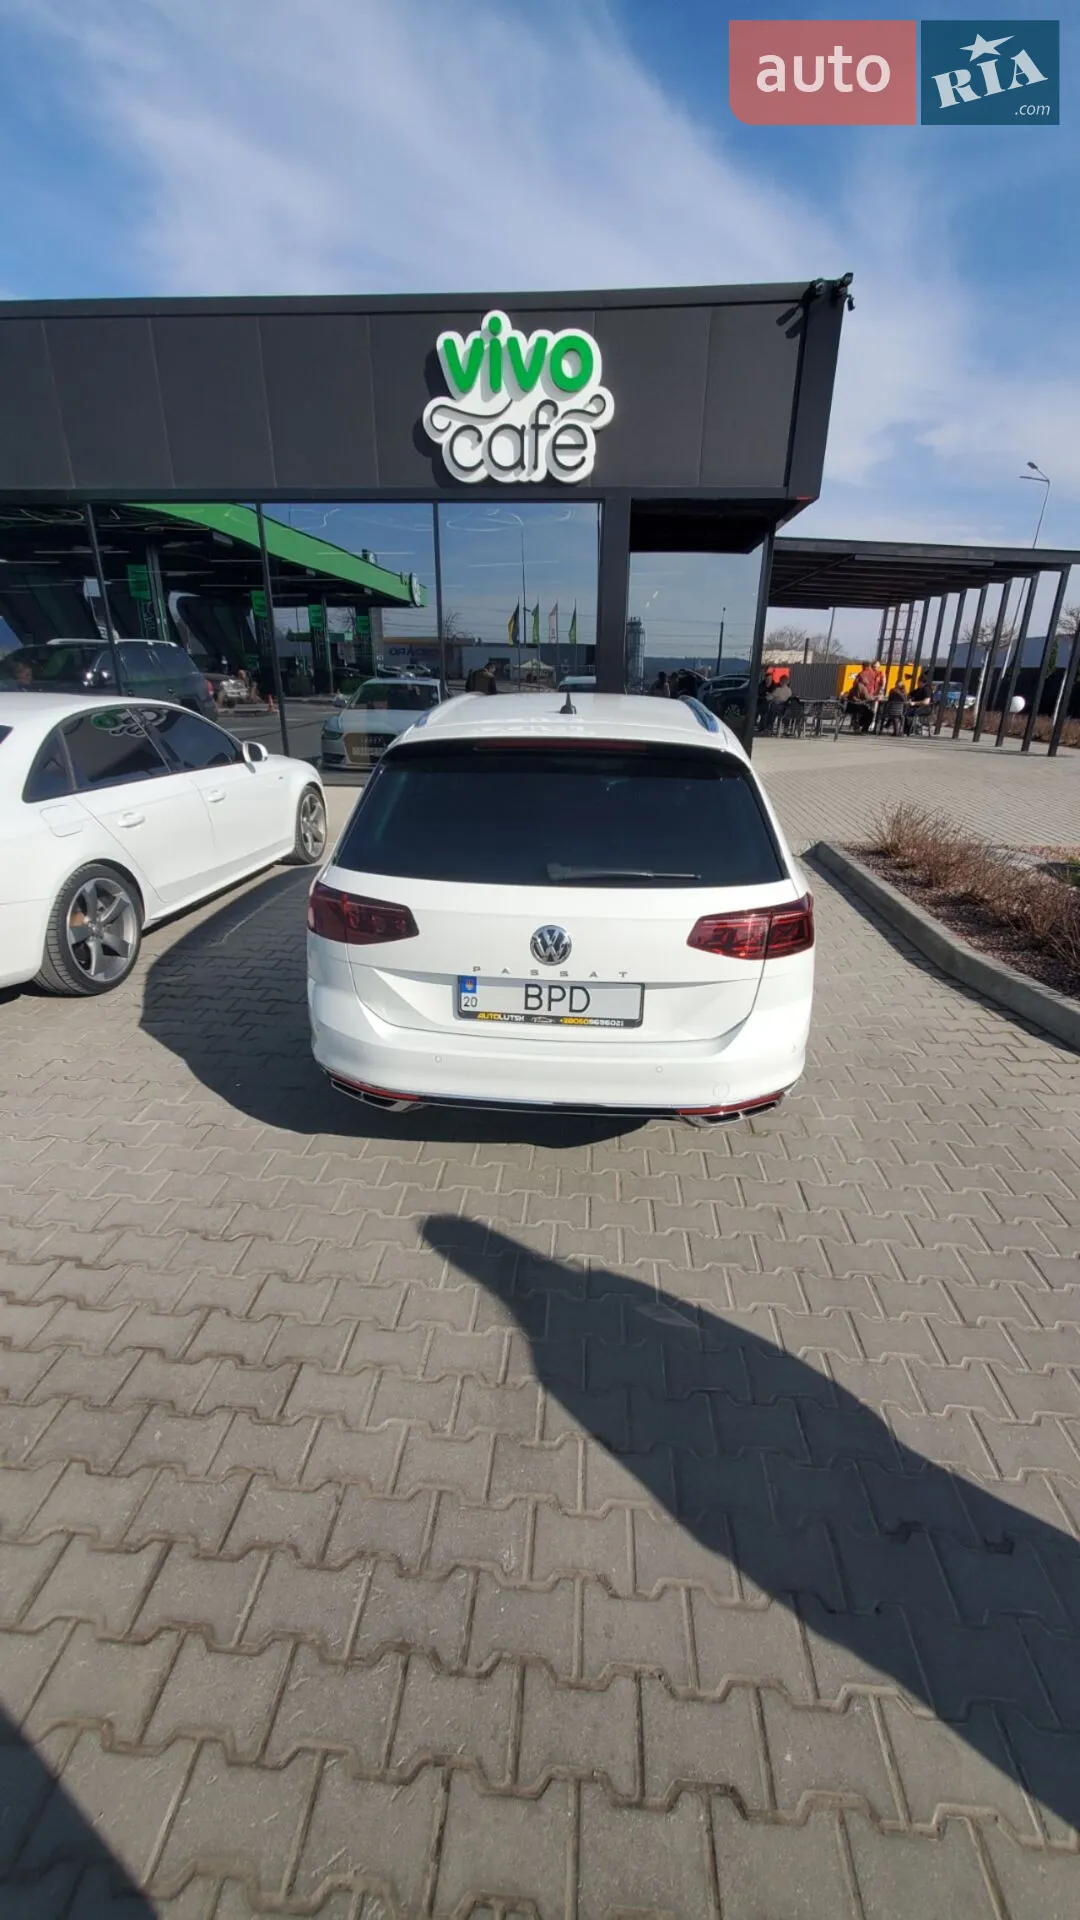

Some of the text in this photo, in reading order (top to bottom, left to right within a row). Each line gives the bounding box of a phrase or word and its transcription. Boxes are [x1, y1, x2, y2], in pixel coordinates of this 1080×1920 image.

[443, 316, 594, 393] vivo
[472, 965, 628, 978] PASSAT
[463, 996, 478, 1008] 20
[524, 983, 591, 1013] BPD
